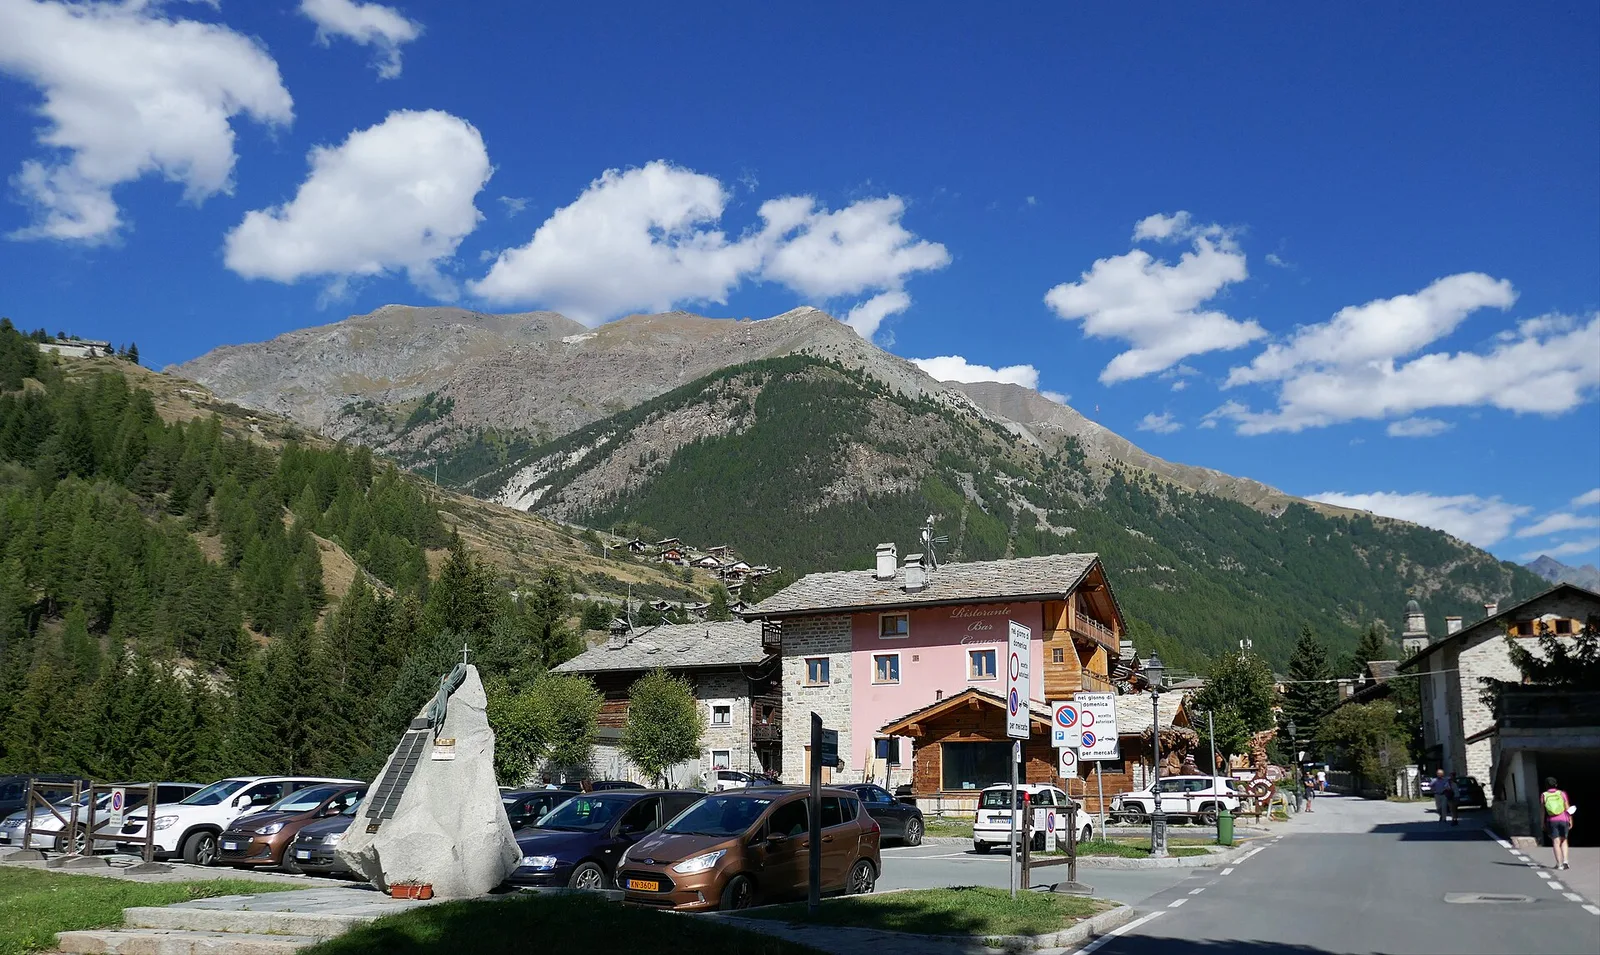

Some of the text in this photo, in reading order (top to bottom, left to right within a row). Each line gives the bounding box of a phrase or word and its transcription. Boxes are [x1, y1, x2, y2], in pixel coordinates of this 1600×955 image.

[949, 606, 1011, 618] Ristorante
[967, 620, 993, 631] Bar
[1056, 731, 1063, 740] P
